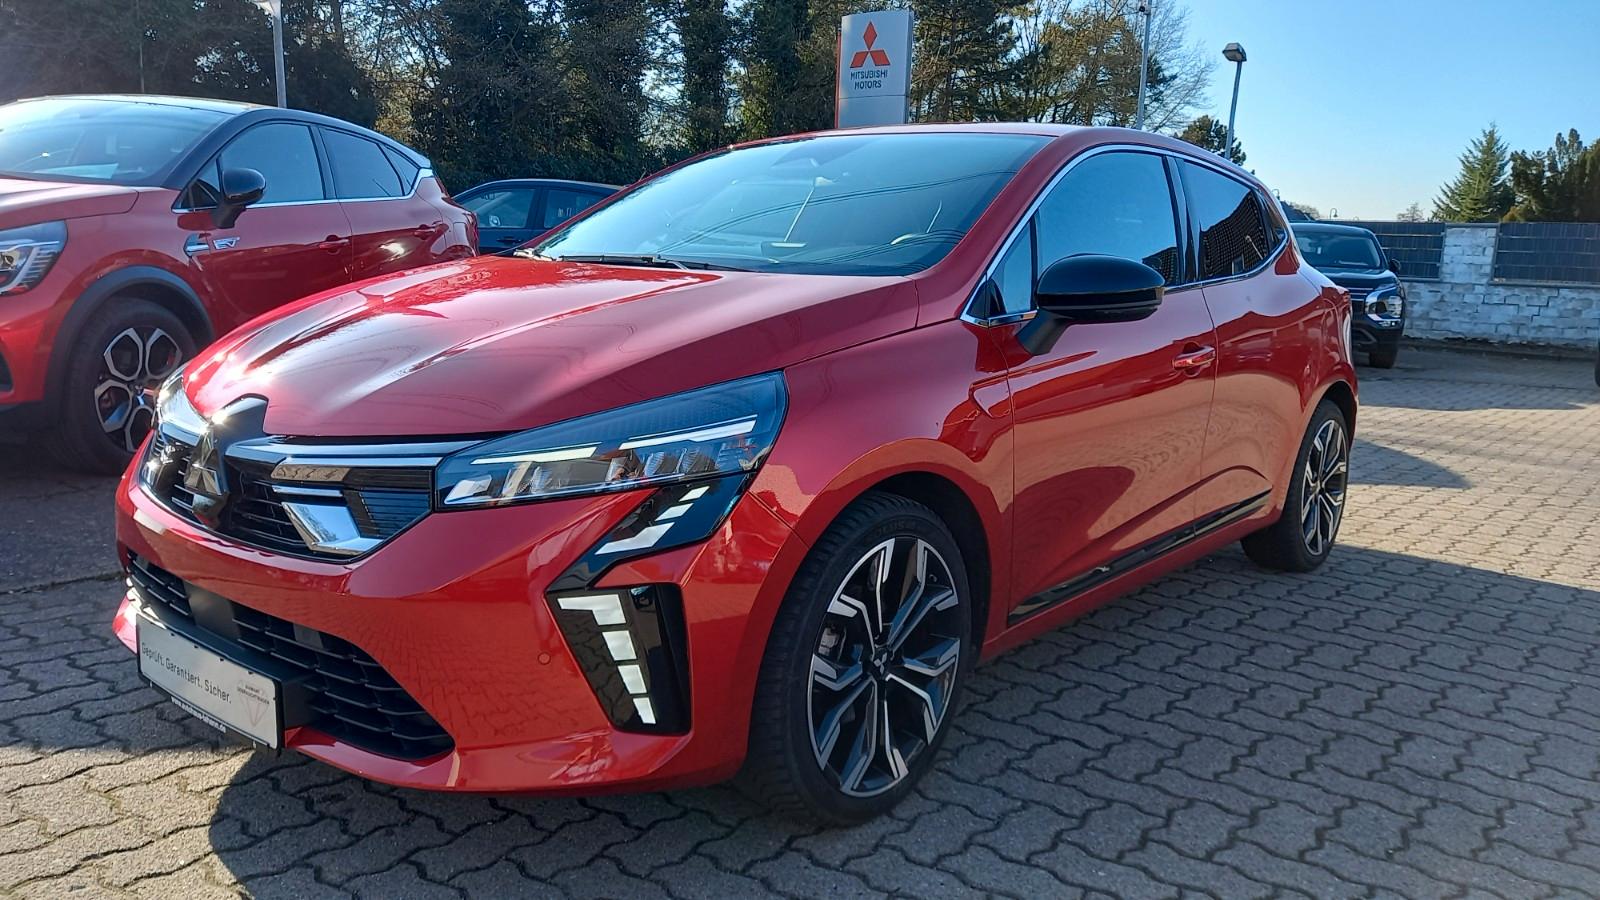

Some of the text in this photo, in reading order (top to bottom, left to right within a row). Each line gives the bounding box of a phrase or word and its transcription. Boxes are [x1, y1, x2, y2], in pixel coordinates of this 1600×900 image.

[851, 69, 888, 80] MITSUBISHI
[854, 80, 882, 90] MOTORS
[165, 657, 203, 688] Garantiert.
[203, 679, 231, 705] Sicher.
